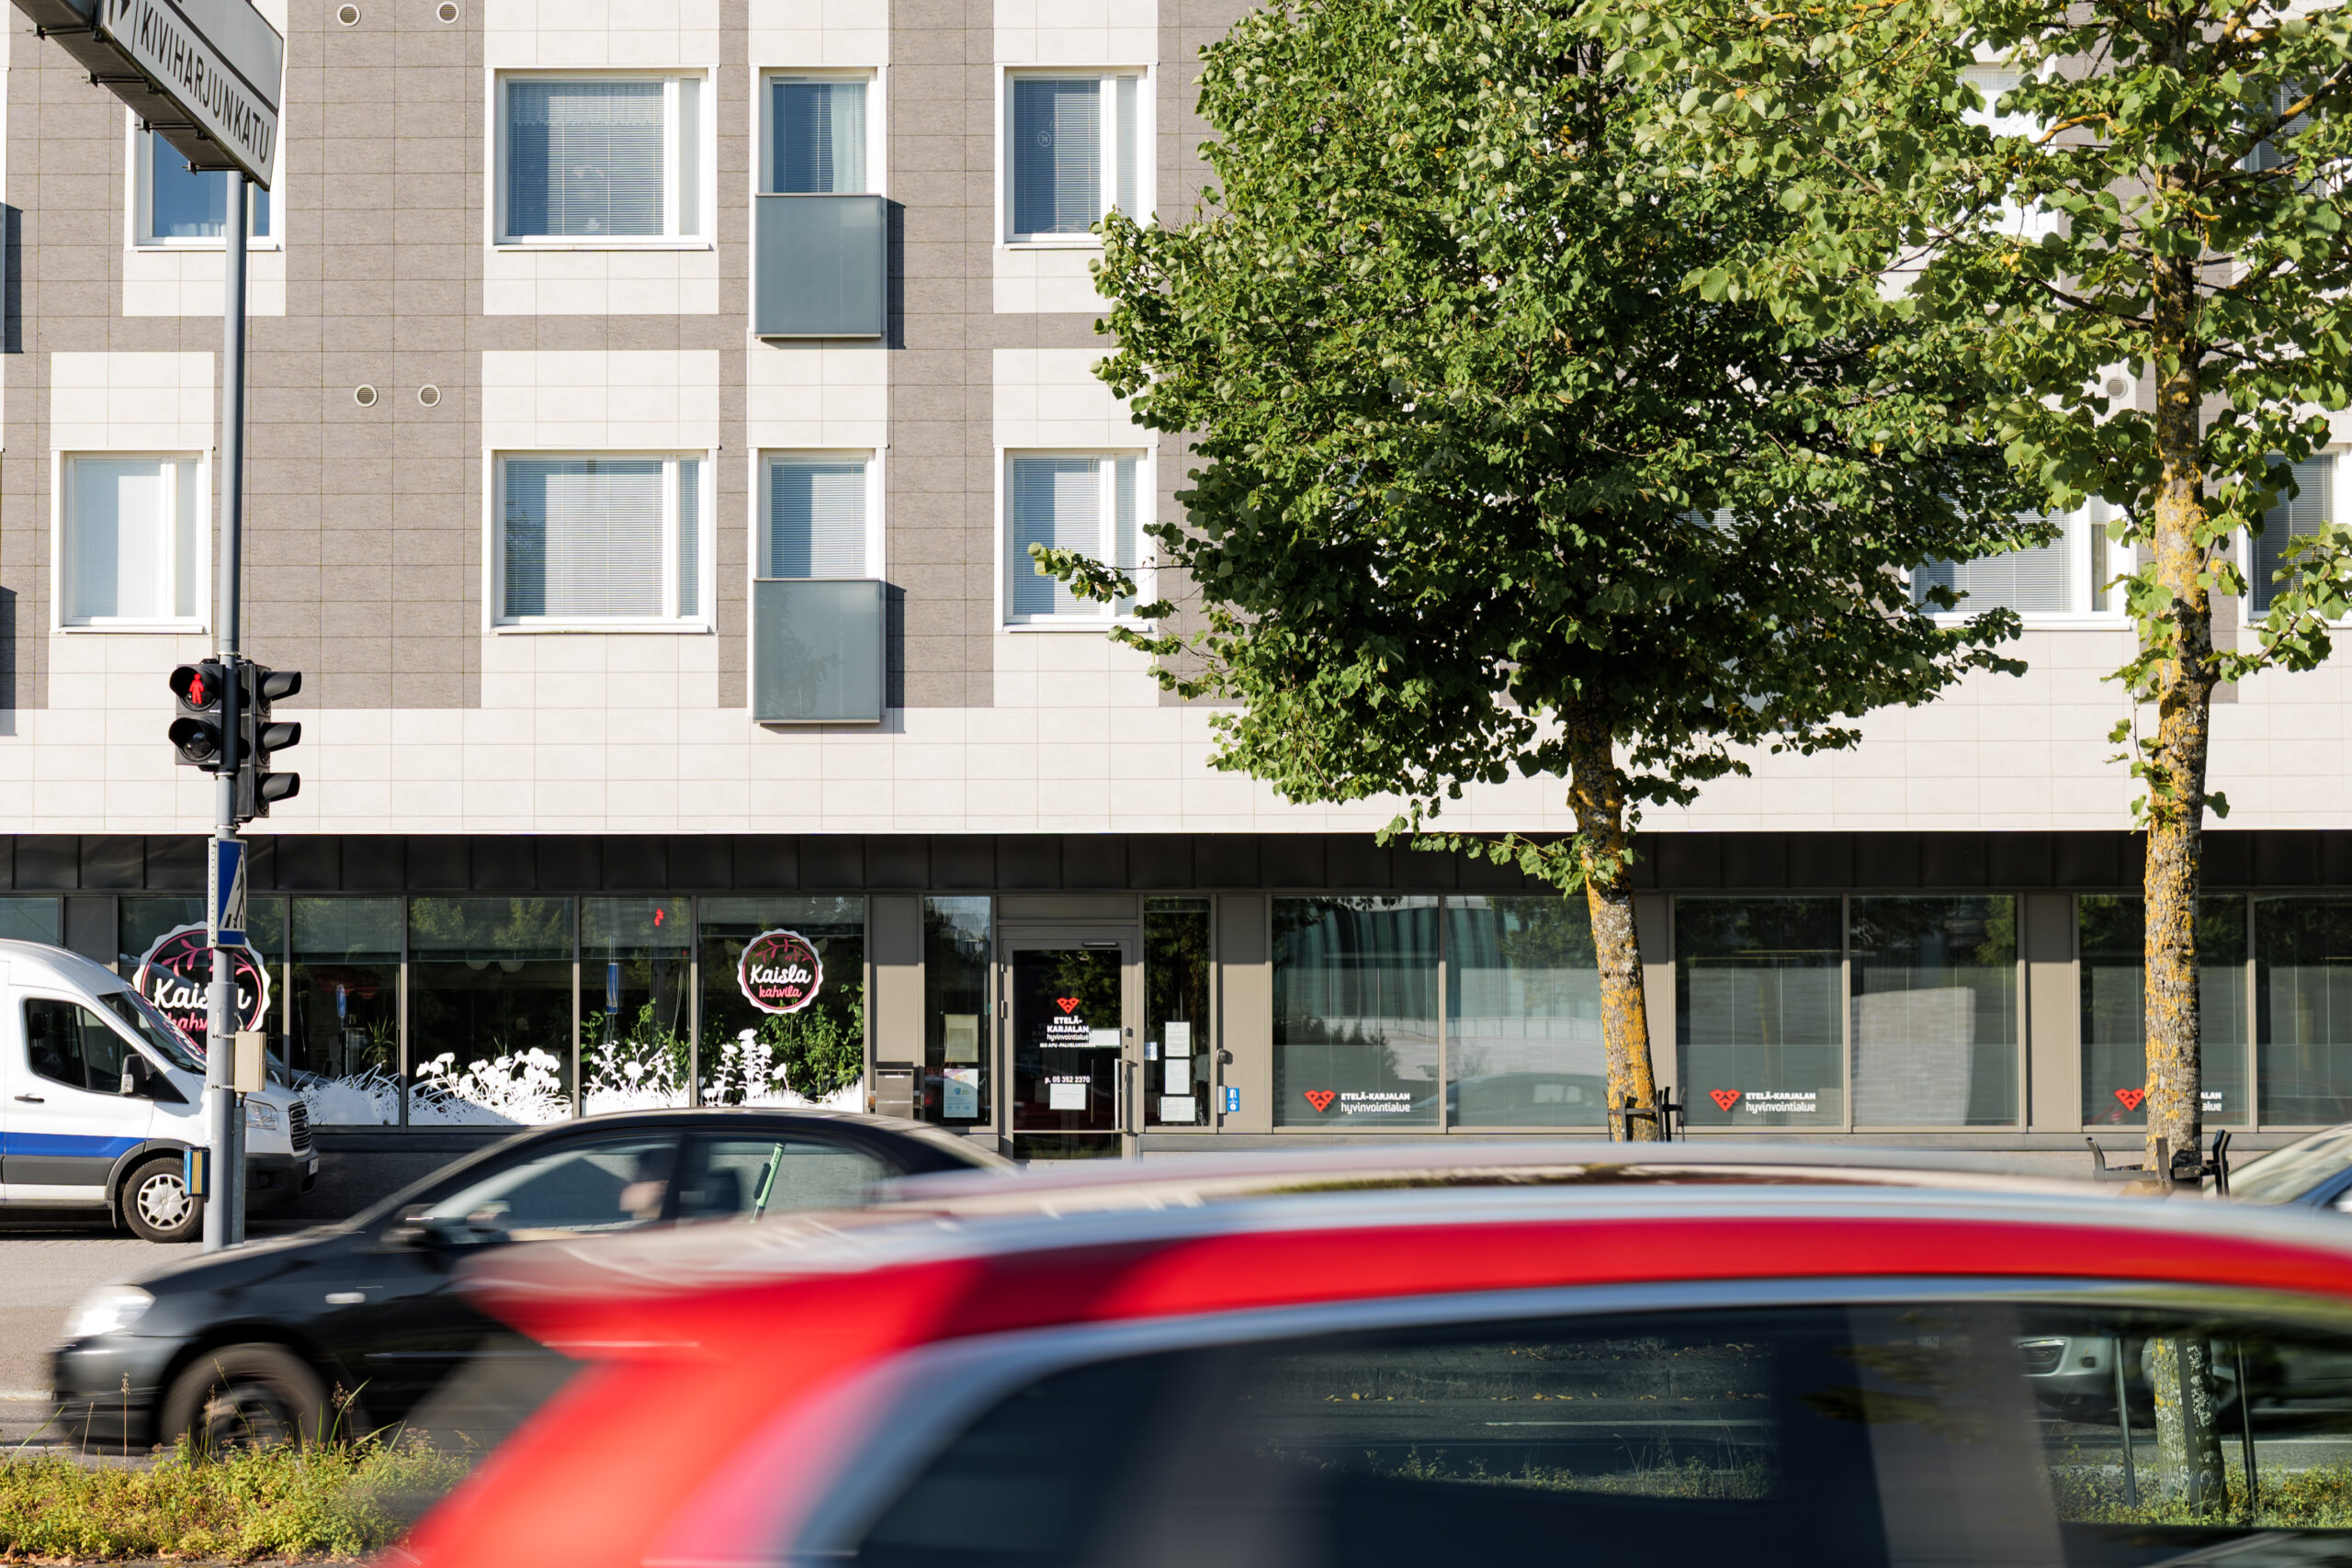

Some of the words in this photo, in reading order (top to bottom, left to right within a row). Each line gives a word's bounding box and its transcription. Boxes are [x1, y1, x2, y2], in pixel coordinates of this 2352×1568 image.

[141, 1, 269, 164] KIVIHARJUNKATU
[750, 964, 811, 984] Kaisla
[154, 977, 252, 1010] Kais
[759, 985, 802, 998] kahvila
[1054, 1015, 1082, 1024] ETELÄ-
[1341, 1091, 1410, 1100] ETELÄ-KARJALAN
[1746, 1091, 1815, 1100] ETELÄ-KARJALAN
[1341, 1101, 1410, 1114] hyvinvointialue
[1746, 1101, 1815, 1114] hyvinvointialue
